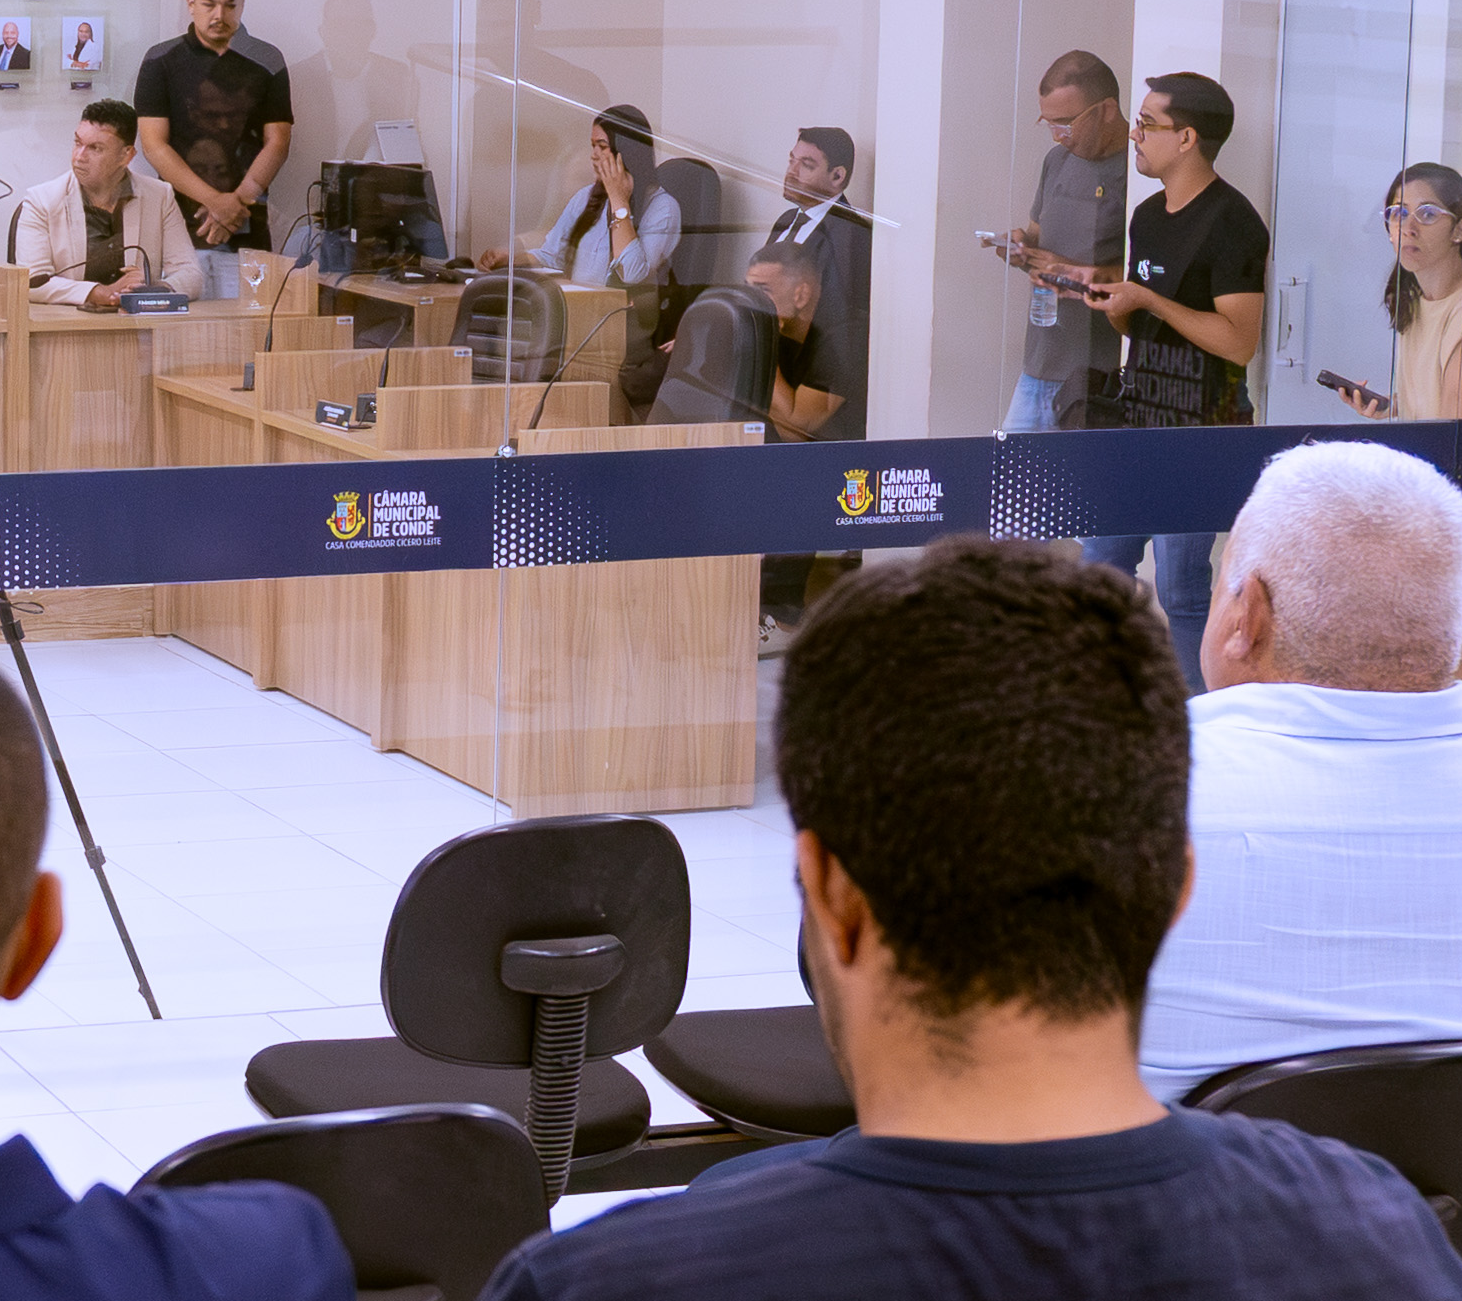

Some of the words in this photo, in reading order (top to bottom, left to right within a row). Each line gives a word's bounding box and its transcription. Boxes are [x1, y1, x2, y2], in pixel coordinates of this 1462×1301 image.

[881, 468, 931, 485] CÂMARA
[374, 489, 427, 508] CÂMARA
[880, 482, 944, 499] MUNICIPAL
[374, 505, 441, 522] MUNICIPAL
[880, 499, 896, 514] DE
[898, 498, 937, 513] CONDE
[835, 516, 854, 526] CASA
[854, 514, 901, 525] COMENDADOR
[926, 512, 944, 522] LEITE
[373, 522, 390, 537] DE
[392, 520, 434, 537] CONDE
[325, 540, 344, 550] CASA
[345, 539, 396, 549] COMENDADOR
[423, 537, 442, 546] LEITE
